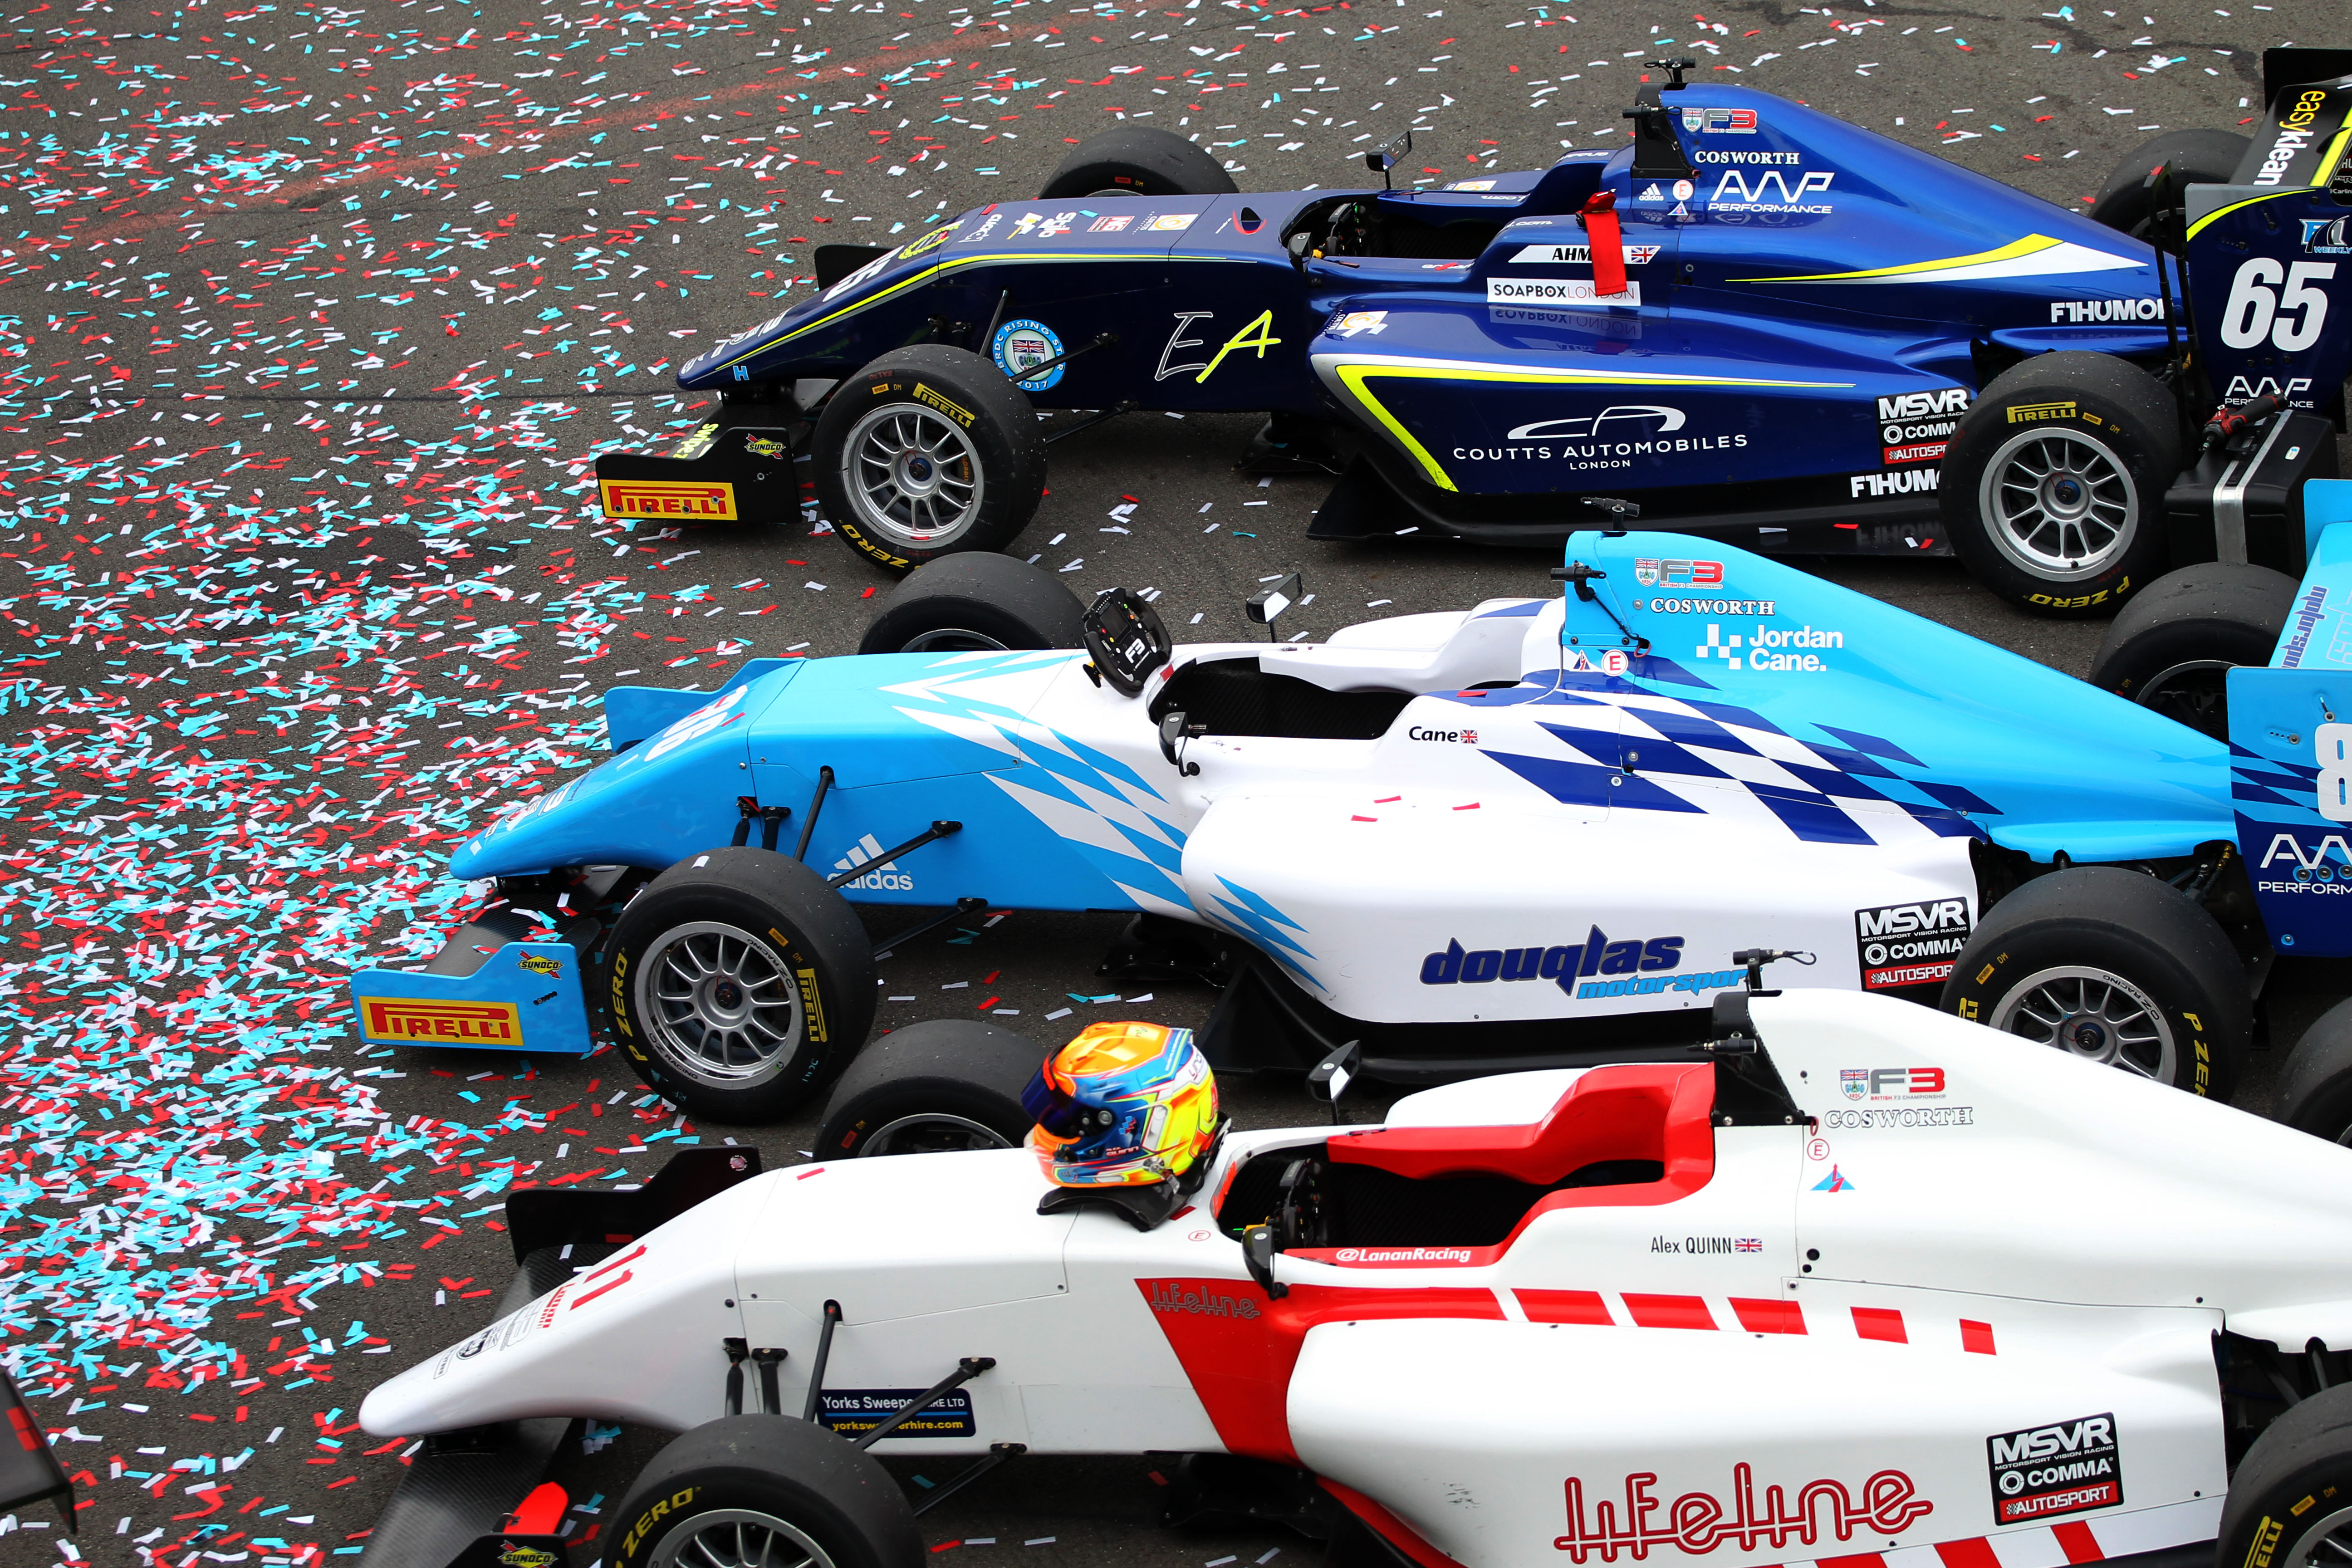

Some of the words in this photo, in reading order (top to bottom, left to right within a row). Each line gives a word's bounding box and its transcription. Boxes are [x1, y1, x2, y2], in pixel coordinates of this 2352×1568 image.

[1703, 109, 1757, 129] F3
[1695, 151, 1799, 164] COSWORTH
[1708, 203, 1833, 214] PERFORMANCE
[1552, 248, 1592, 261] AHM
[2314, 245, 2352, 254] WEEKLY
[2220, 257, 2337, 351] 65
[995, 334, 1005, 368] BRDC
[1004, 321, 1050, 335] RISING
[1052, 339, 1064, 371] STR
[912, 382, 975, 428] PIRELLI
[1878, 389, 1969, 419] MSVR
[2007, 401, 2076, 424] PIRELLI
[2225, 398, 2313, 408] PERFNCE
[1881, 416, 1922, 424] MOTORSPORT
[1905, 422, 1956, 439] COMM
[1453, 447, 1551, 460] COUTTS
[1563, 435, 1748, 459] AUTOMOBILES
[1896, 445, 1947, 460] AUTOSP
[1570, 460, 1631, 470] LONDON
[1851, 469, 1940, 498] F1HUM
[608, 485, 727, 514] PIRELLI
[842, 524, 909, 568] ZERO
[1660, 559, 1724, 583] F3
[2117, 575, 2131, 595] P
[1650, 598, 1775, 616] COSWORTH
[2029, 589, 2108, 608] ZERO
[1749, 625, 1843, 648] Jordan
[1125, 638, 1145, 663] F3
[1749, 648, 1827, 671] Cane.
[1609, 655, 1621, 671] E
[1409, 726, 1458, 742] Cane
[2259, 881, 2352, 895] PERFORM
[1859, 901, 1966, 936] MSVR
[1862, 933, 1911, 942] MOTORSPORT
[1890, 938, 1963, 959] COMMA
[519, 960, 560, 970] SUNOCO
[747, 938, 780, 971] RACING
[793, 953, 803, 963] DM
[1420, 924, 1685, 996] douglas
[1997, 952, 2009, 964] DM
[1576, 967, 1750, 1000] motorspor
[1881, 964, 1955, 984] AUTOSPOR
[612, 952, 633, 1038] ZERO
[2102, 975, 2141, 999] RACING
[797, 968, 828, 1042] PIRELLI
[369, 1003, 511, 1039] PIRELLI
[628, 1045, 648, 1062] P
[2183, 1012, 2203, 1031] P
[2194, 1039, 2209, 1097] ZER
[664, 1052, 698, 1080] RACING
[1870, 1067, 1945, 1094] F3
[1824, 1107, 1973, 1128] COSWORTH
[1336, 1248, 1471, 1262] @LananRacing
[1651, 1235, 1681, 1253] Alex
[1686, 1237, 1732, 1254] QUINN
[822, 1396, 859, 1409] Yorks
[948, 1398, 965, 1407] LTD
[1992, 1417, 2114, 1465] MSVR
[1995, 1456, 2051, 1470] MOTORSPORT
[2054, 1451, 2082, 1460] VISION
[2084, 1445, 2114, 1455] RACING
[2027, 1458, 2112, 1487] COMMA
[2016, 1485, 2109, 1515] AUTOSPORT
[2324, 1486, 2337, 1498] DM
[622, 1486, 694, 1558] ZERO
[505, 1553, 551, 1563] SUNOCO
